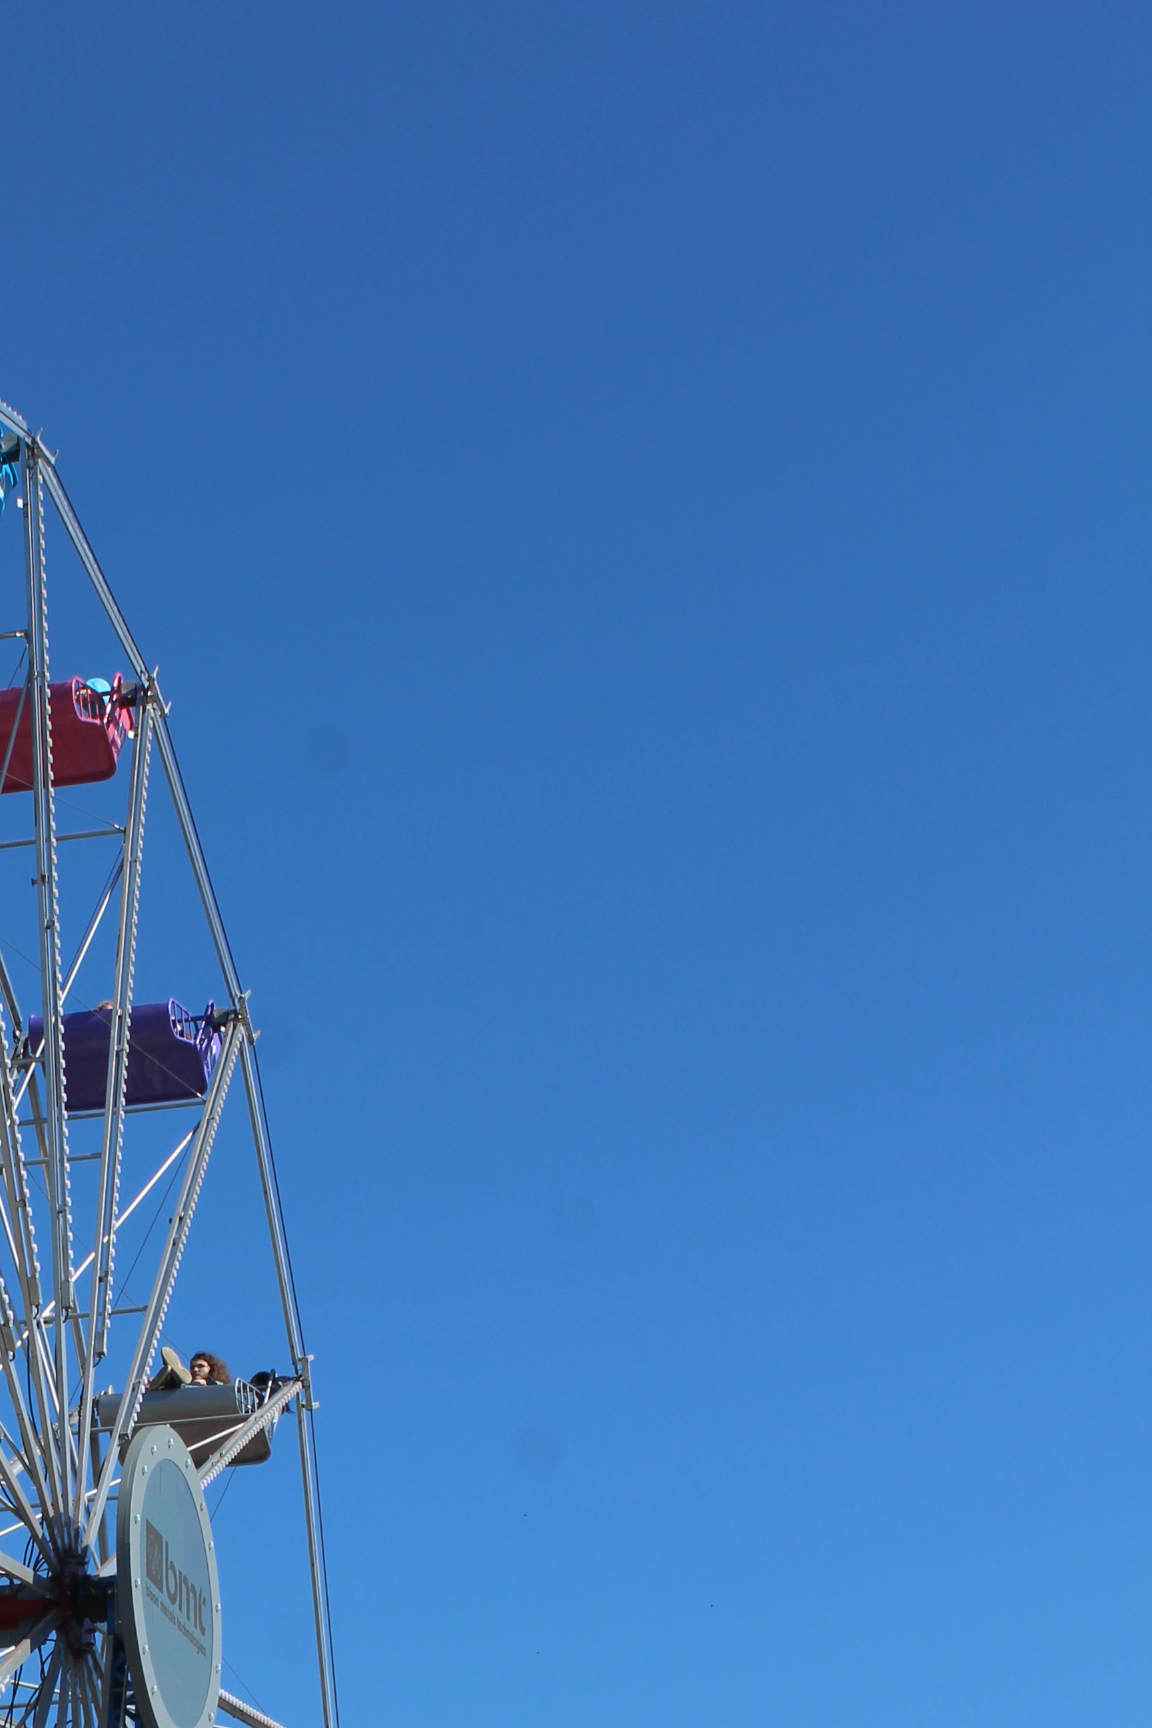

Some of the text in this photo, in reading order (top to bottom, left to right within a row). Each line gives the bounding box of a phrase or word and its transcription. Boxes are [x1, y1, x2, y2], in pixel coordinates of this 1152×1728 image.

[145, 1582, 206, 1657] bison metals technologies
[165, 1540, 206, 1636] bmt
